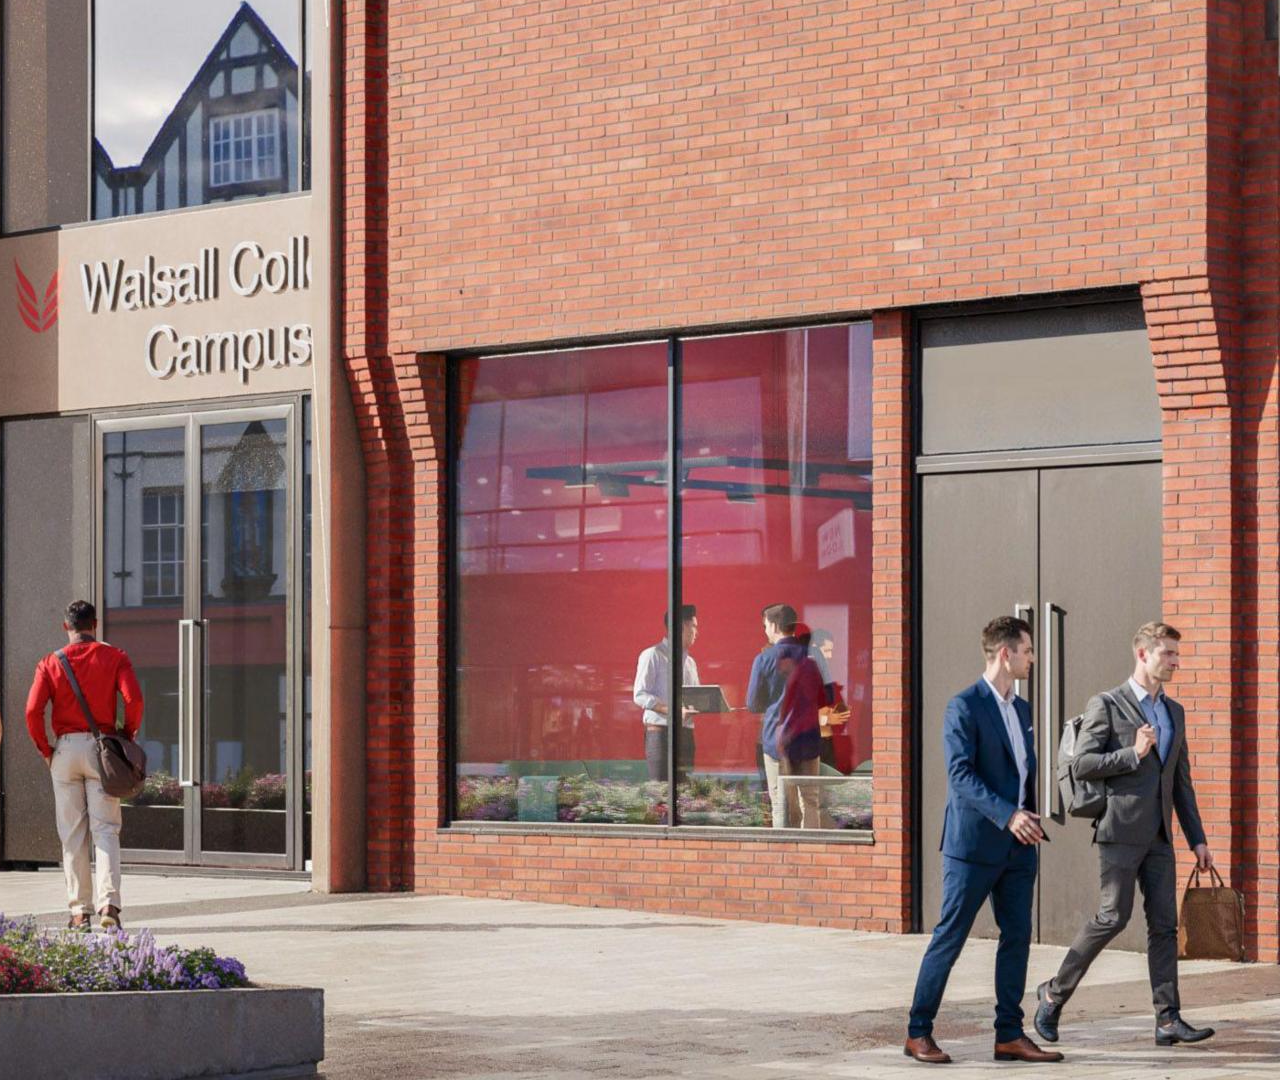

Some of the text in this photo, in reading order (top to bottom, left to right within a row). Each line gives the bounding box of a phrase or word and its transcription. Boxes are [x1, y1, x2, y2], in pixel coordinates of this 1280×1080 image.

[80, 234, 312, 314] Walsall Coll
[144, 322, 313, 386] Campus
